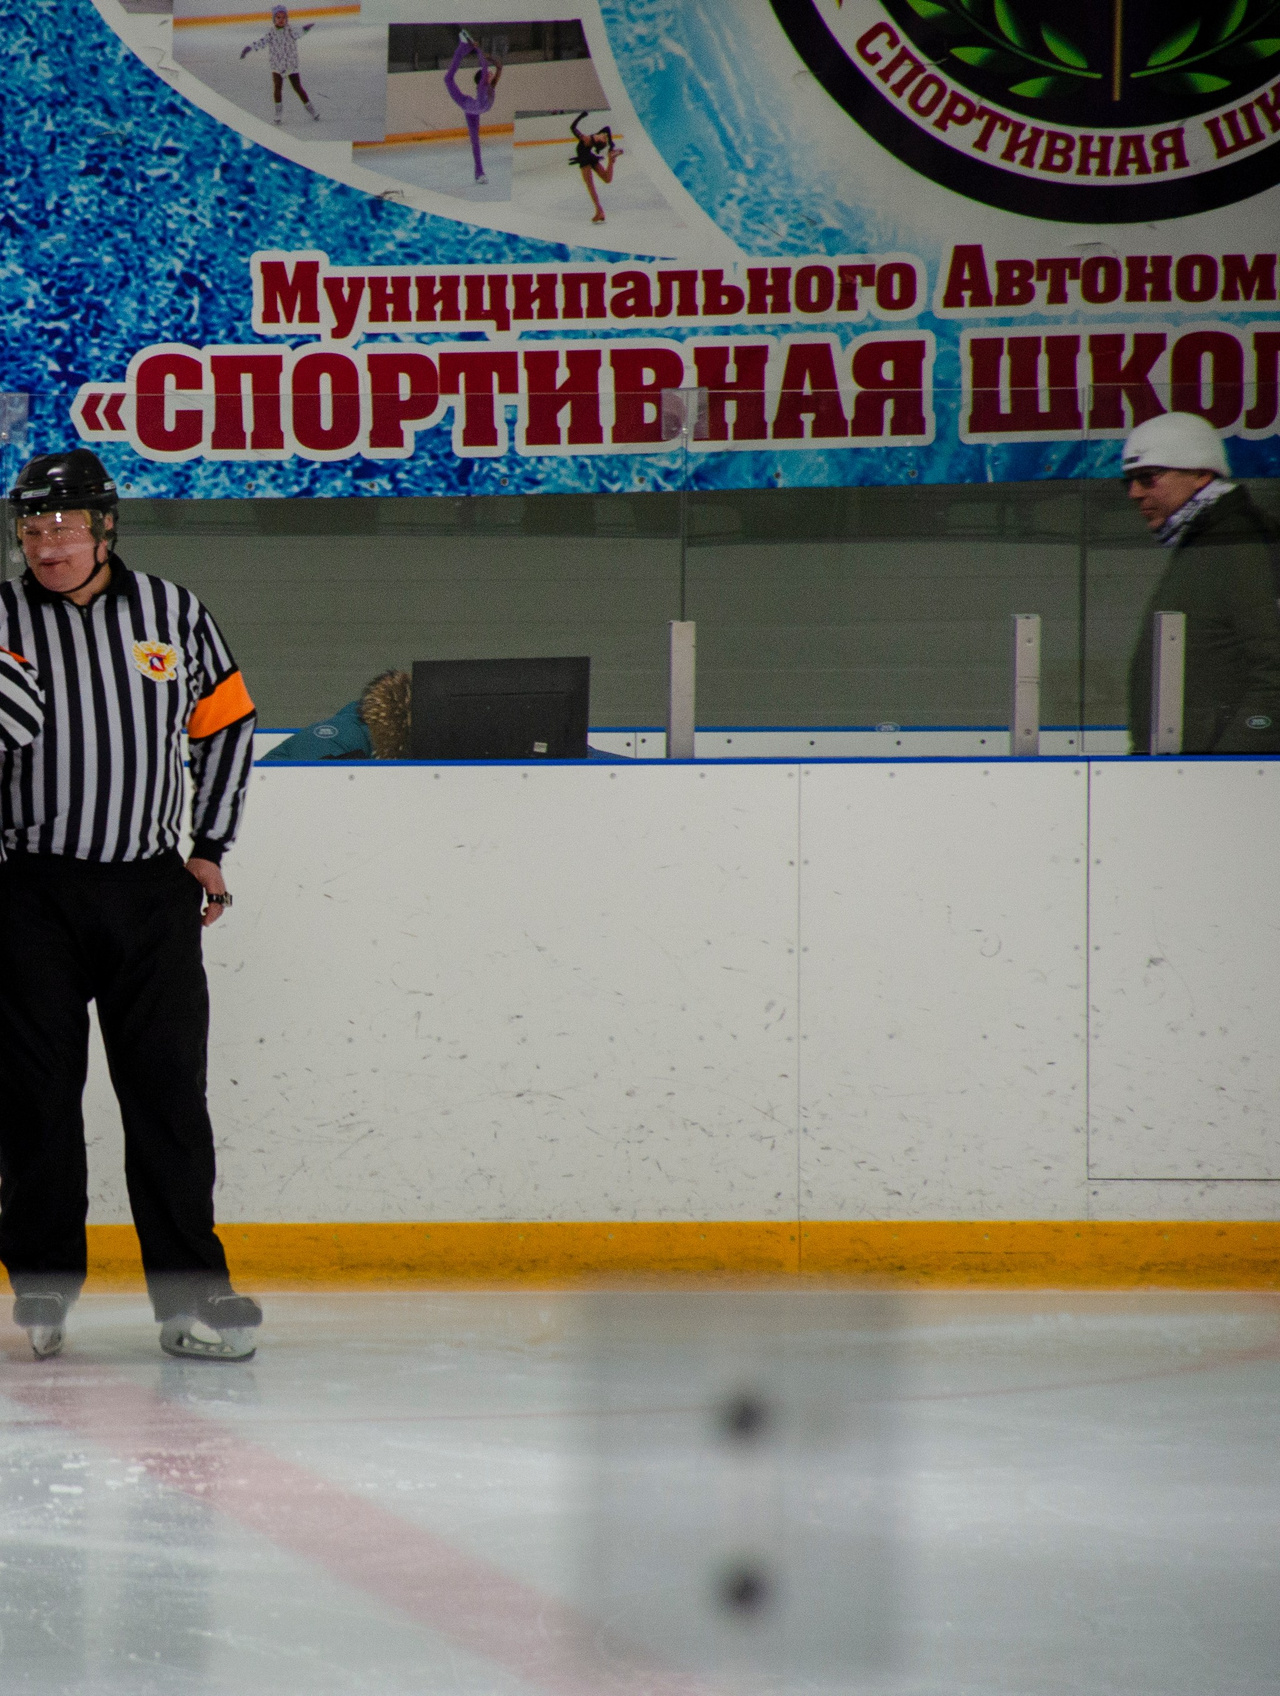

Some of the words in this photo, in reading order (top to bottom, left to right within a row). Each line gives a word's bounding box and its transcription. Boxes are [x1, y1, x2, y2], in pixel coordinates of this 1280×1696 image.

[855, 21, 1190, 177] СПОРТИВНАЯ
[260, 260, 917, 337] Муниципального
[944, 244, 1278, 306] Автоном
[81, 338, 928, 452] «СПОРТИВНАЯ
